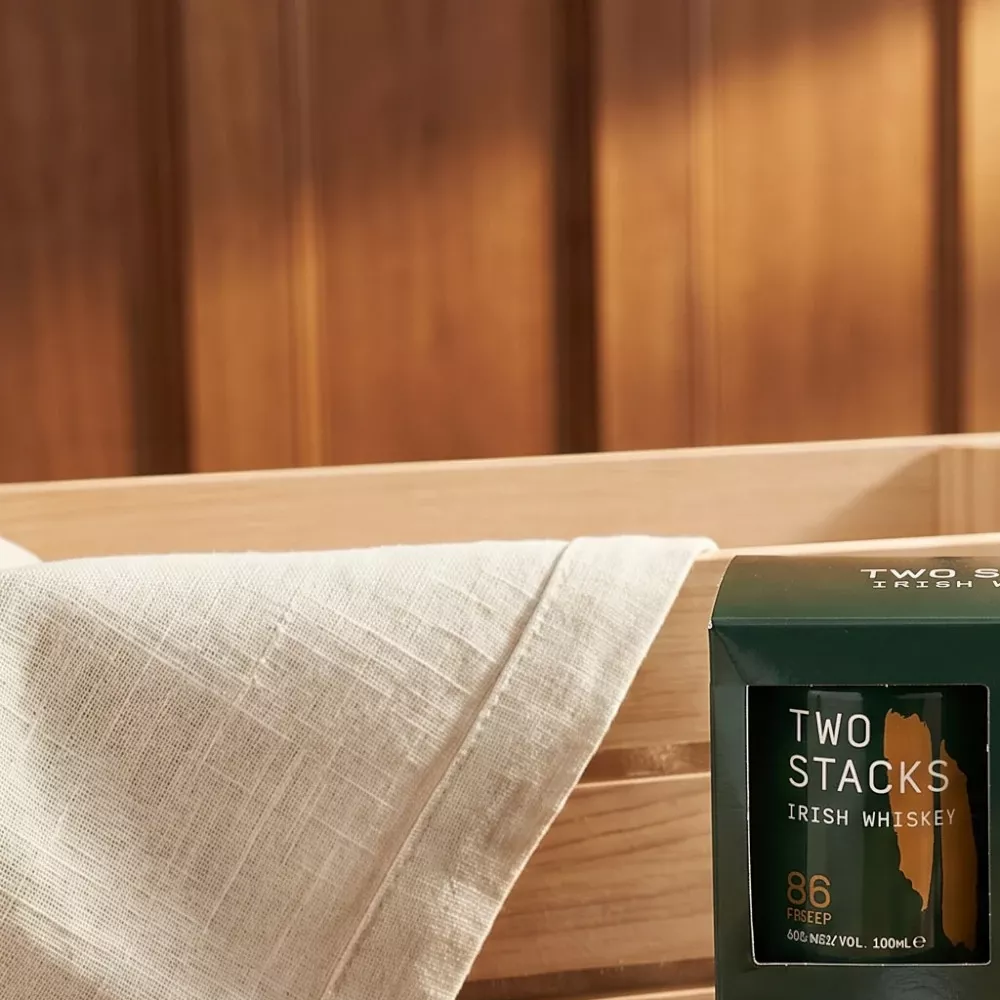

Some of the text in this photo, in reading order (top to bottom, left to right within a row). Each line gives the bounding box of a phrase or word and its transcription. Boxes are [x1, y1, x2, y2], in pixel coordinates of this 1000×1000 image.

[860, 568, 957, 579] TWO
[872, 580, 973, 588] IRISH
[789, 708, 871, 748] TWO
[788, 755, 949, 794] STACKS
[787, 803, 956, 829] IRISH WHISKEY
[787, 871, 831, 909] 86
